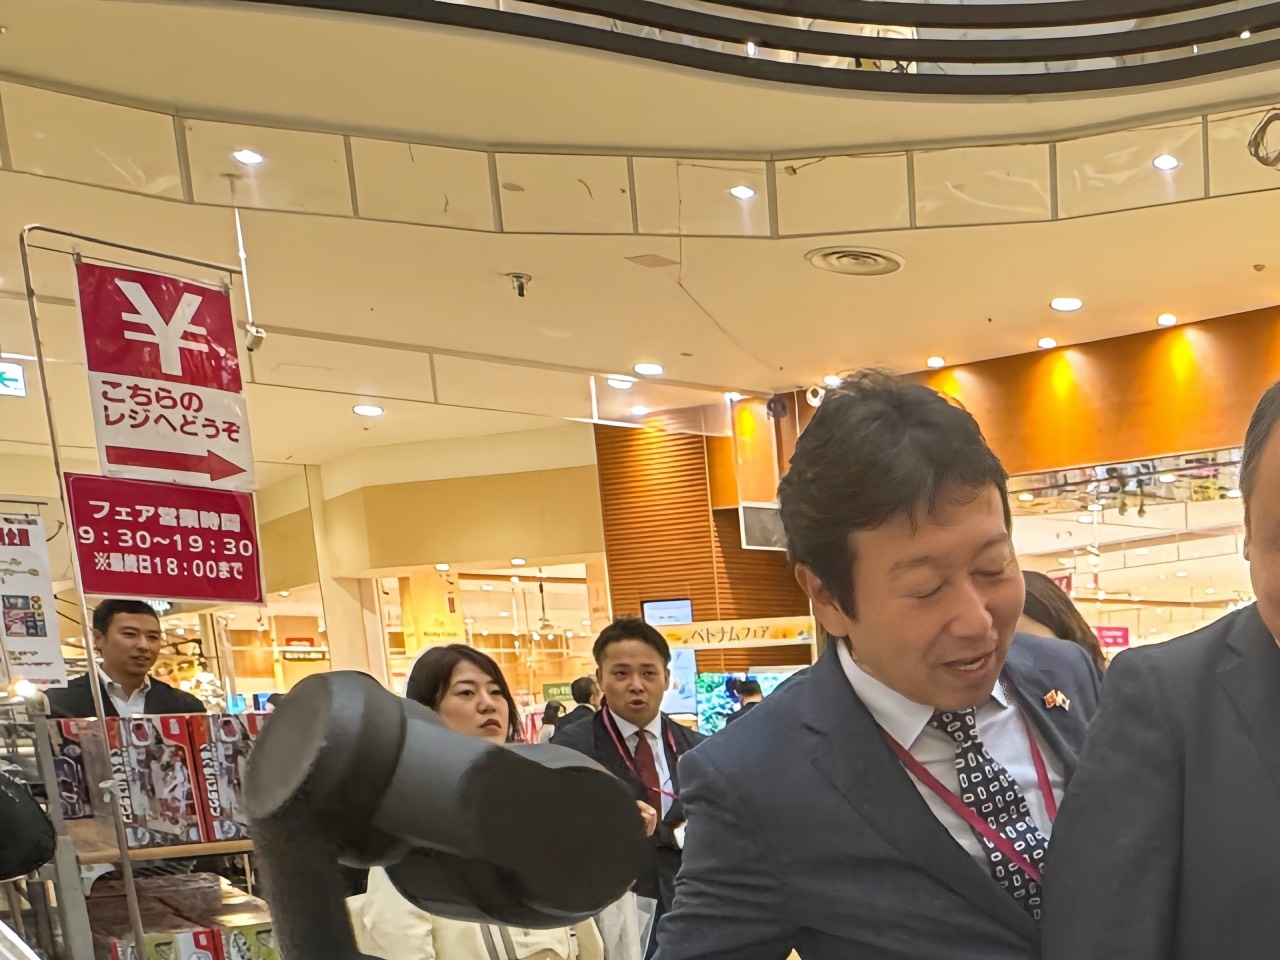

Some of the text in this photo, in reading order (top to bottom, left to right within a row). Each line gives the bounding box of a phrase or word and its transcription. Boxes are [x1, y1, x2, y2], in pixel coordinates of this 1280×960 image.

[101, 379, 204, 414] こちらの
[103, 406, 241, 443] レジへどうぞ
[691, 625, 769, 643] ベトナムフェア
